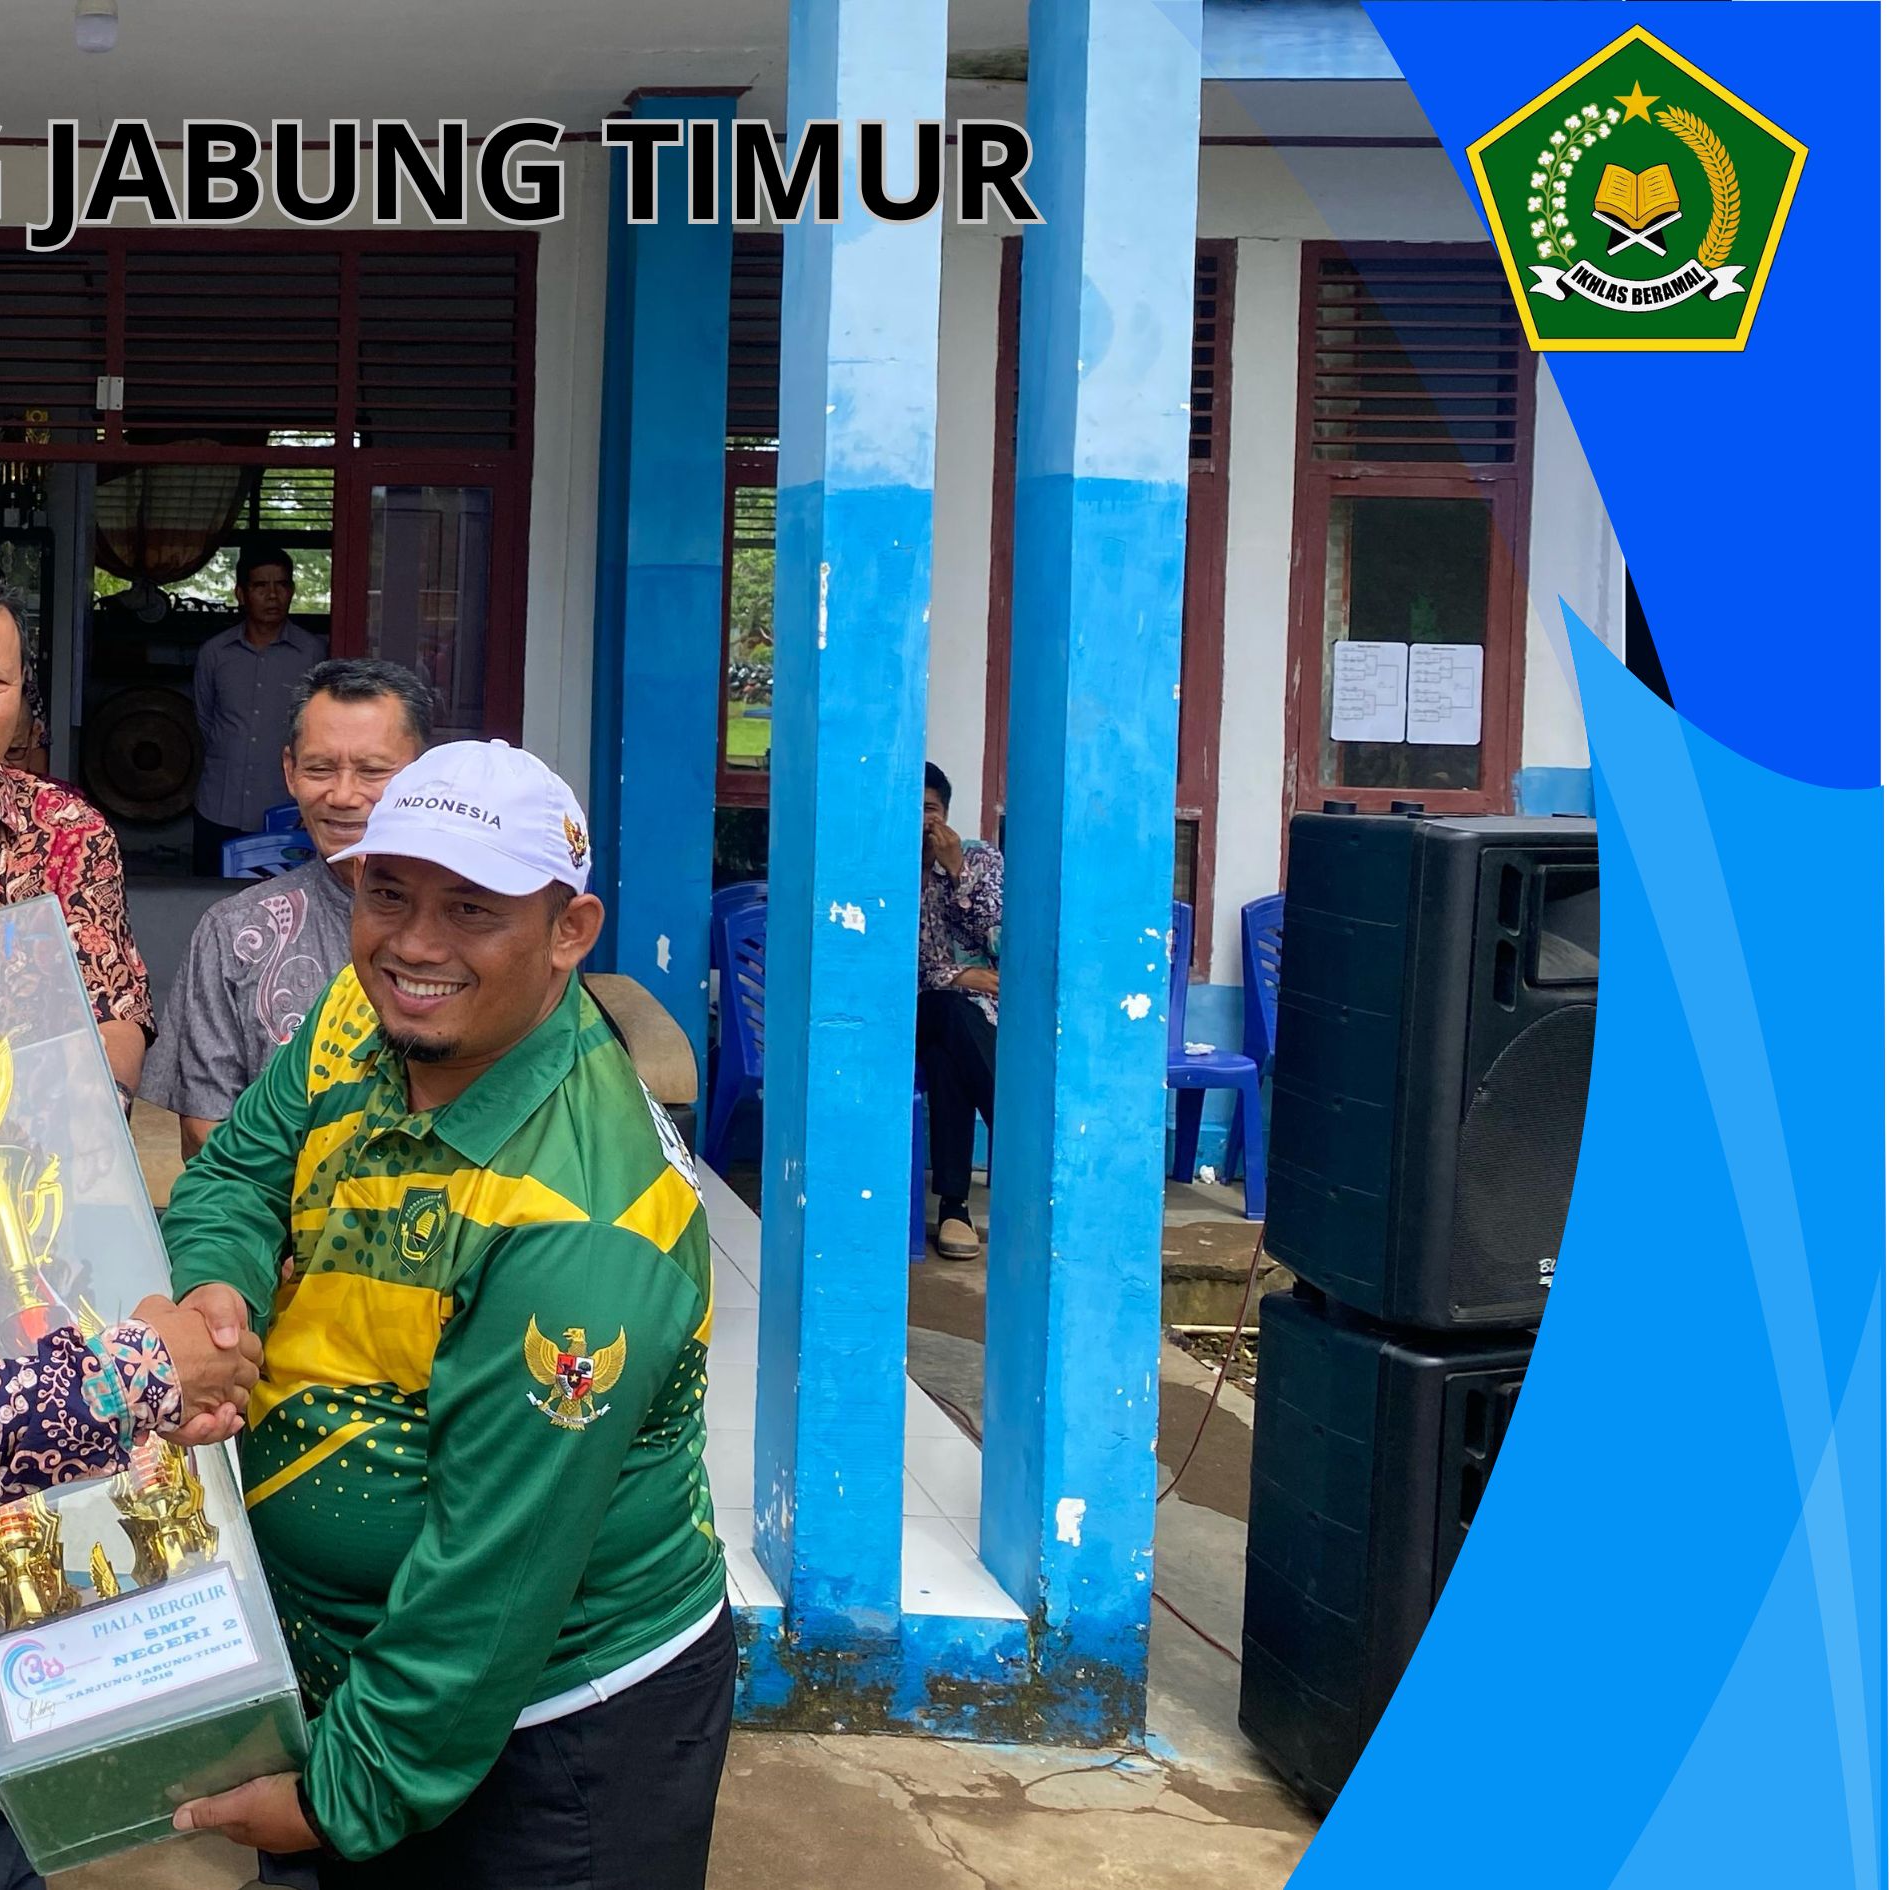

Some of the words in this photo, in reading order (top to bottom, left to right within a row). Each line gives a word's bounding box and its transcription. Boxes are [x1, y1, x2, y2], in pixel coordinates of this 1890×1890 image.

[393, 796, 501, 830] INDONESIA
[92, 1611, 143, 1638] PIALA
[148, 1584, 227, 1621] BERGILIR
[143, 1615, 197, 1641] SMP
[112, 1626, 212, 1667] NEGERI
[222, 1618, 238, 1631] 2
[66, 1674, 132, 1700] TANJUNG
[135, 1655, 192, 1678] JABUNG
[195, 1638, 243, 1658] TIMUR
